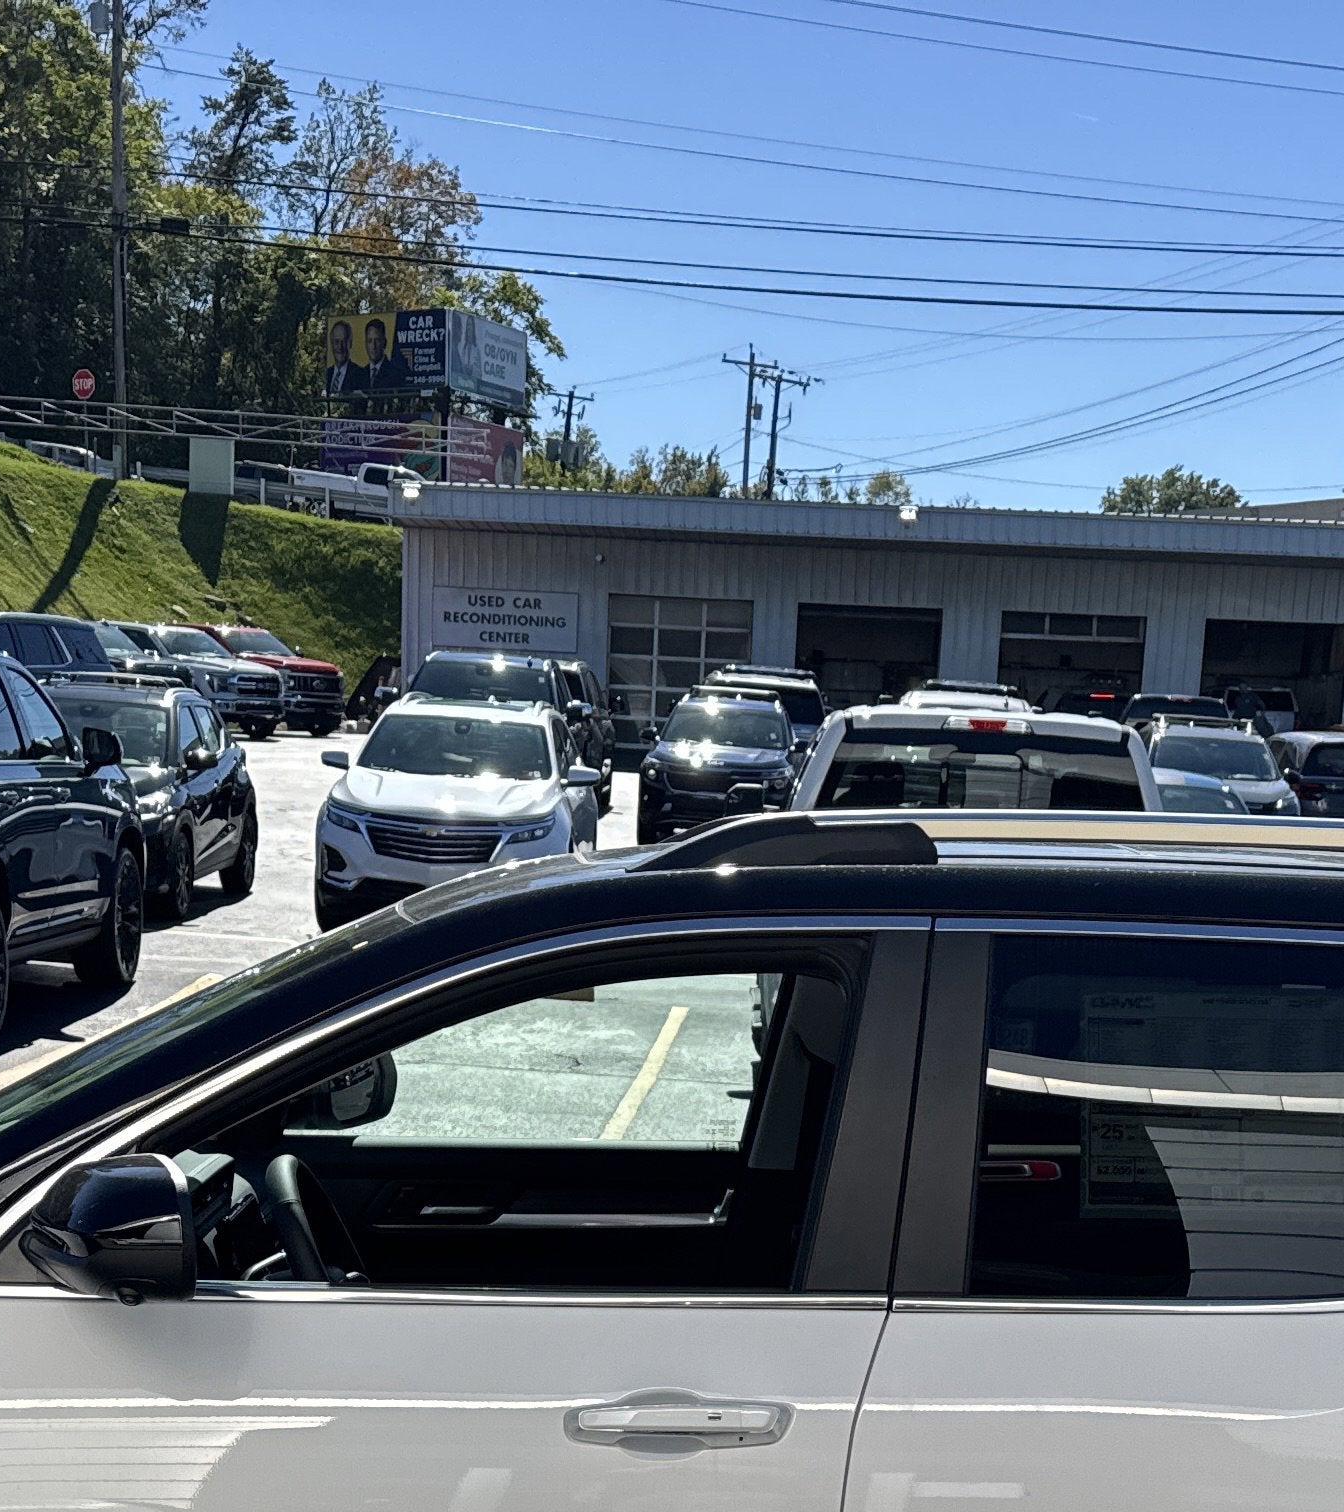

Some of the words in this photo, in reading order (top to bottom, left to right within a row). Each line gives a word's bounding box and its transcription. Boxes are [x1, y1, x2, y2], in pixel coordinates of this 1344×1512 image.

[409, 316, 434, 329] CAR
[397, 328, 445, 343] WRECK?
[484, 343, 518, 366] OB/GYN
[483, 361, 506, 380] CARE
[75, 378, 93, 390] STOP
[467, 594, 505, 608] USED
[512, 597, 543, 610] CAR
[443, 610, 567, 629] RECONDITIONING
[479, 631, 531, 644] CENTER
